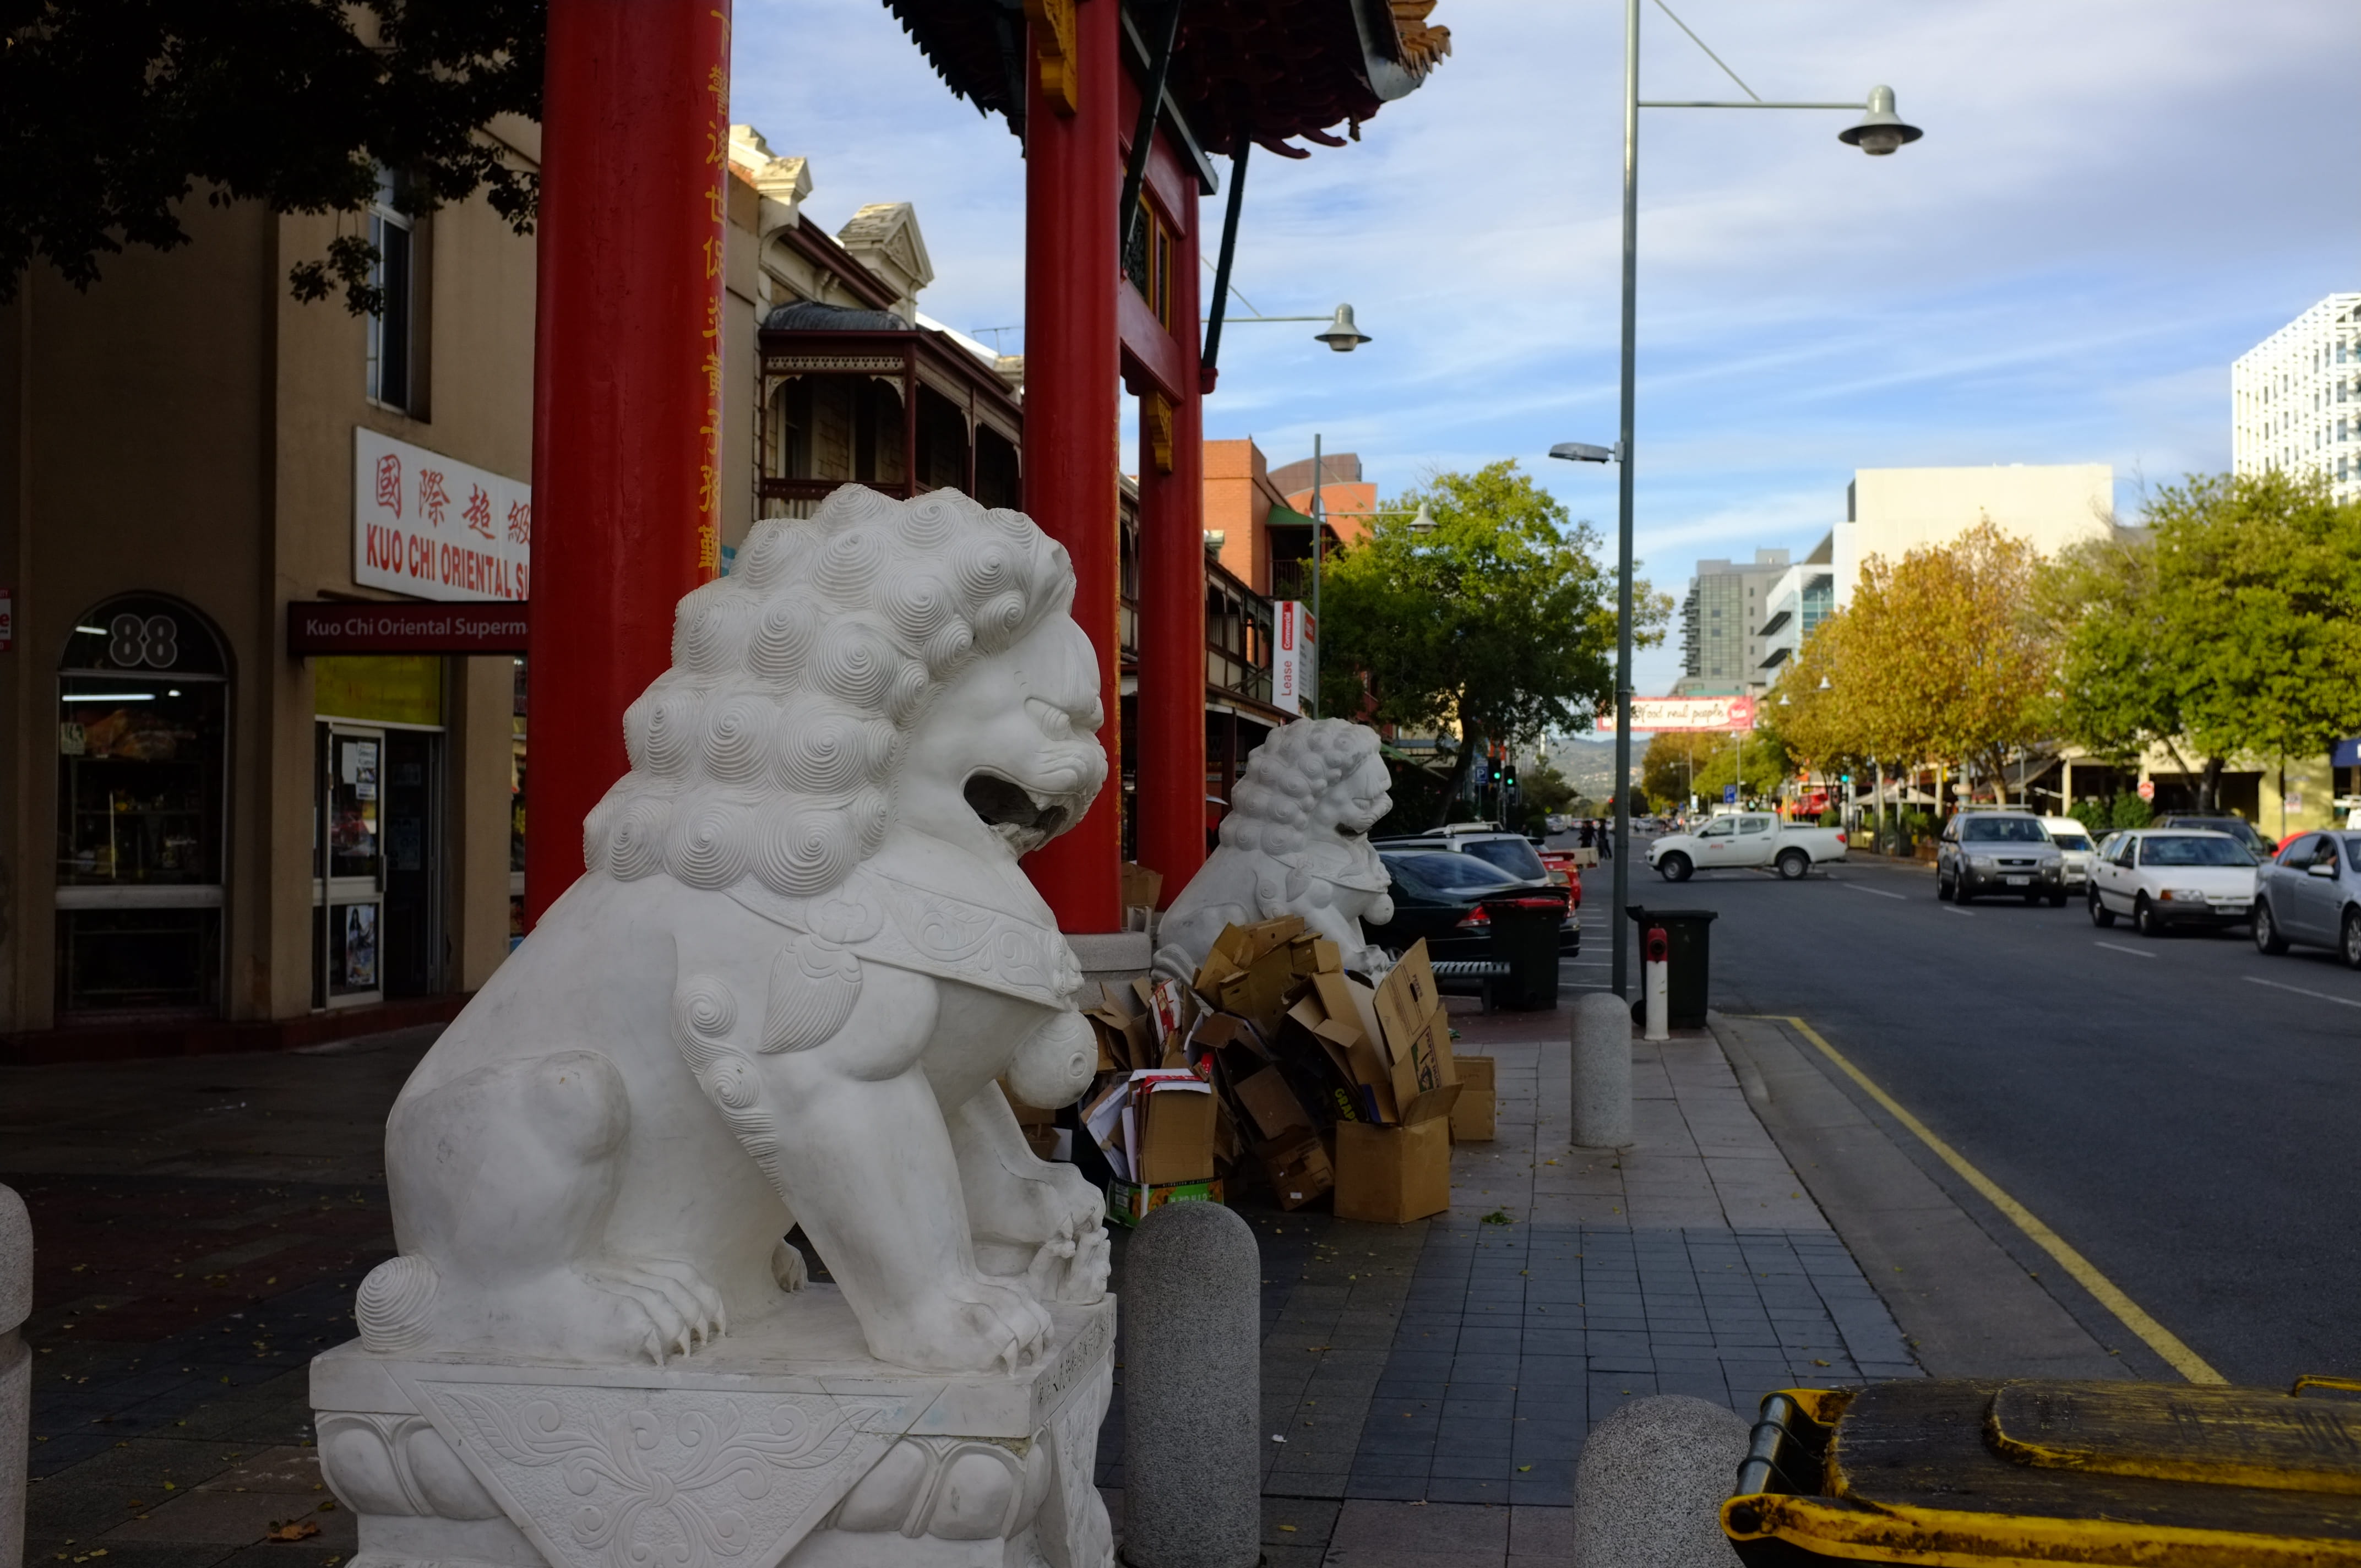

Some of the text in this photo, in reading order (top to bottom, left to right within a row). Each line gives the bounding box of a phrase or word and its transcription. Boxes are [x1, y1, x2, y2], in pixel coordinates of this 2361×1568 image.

[367, 522, 402, 574] KUO
[409, 534, 435, 581] CHI
[442, 543, 511, 599] ORIENTAL
[110, 613, 177, 668] 88
[307, 619, 341, 635] Kuo
[345, 618, 373, 635] Chi
[378, 617, 451, 635] Oriental
[1283, 612, 1292, 649] Commercial
[1281, 661, 1292, 696] Lease
